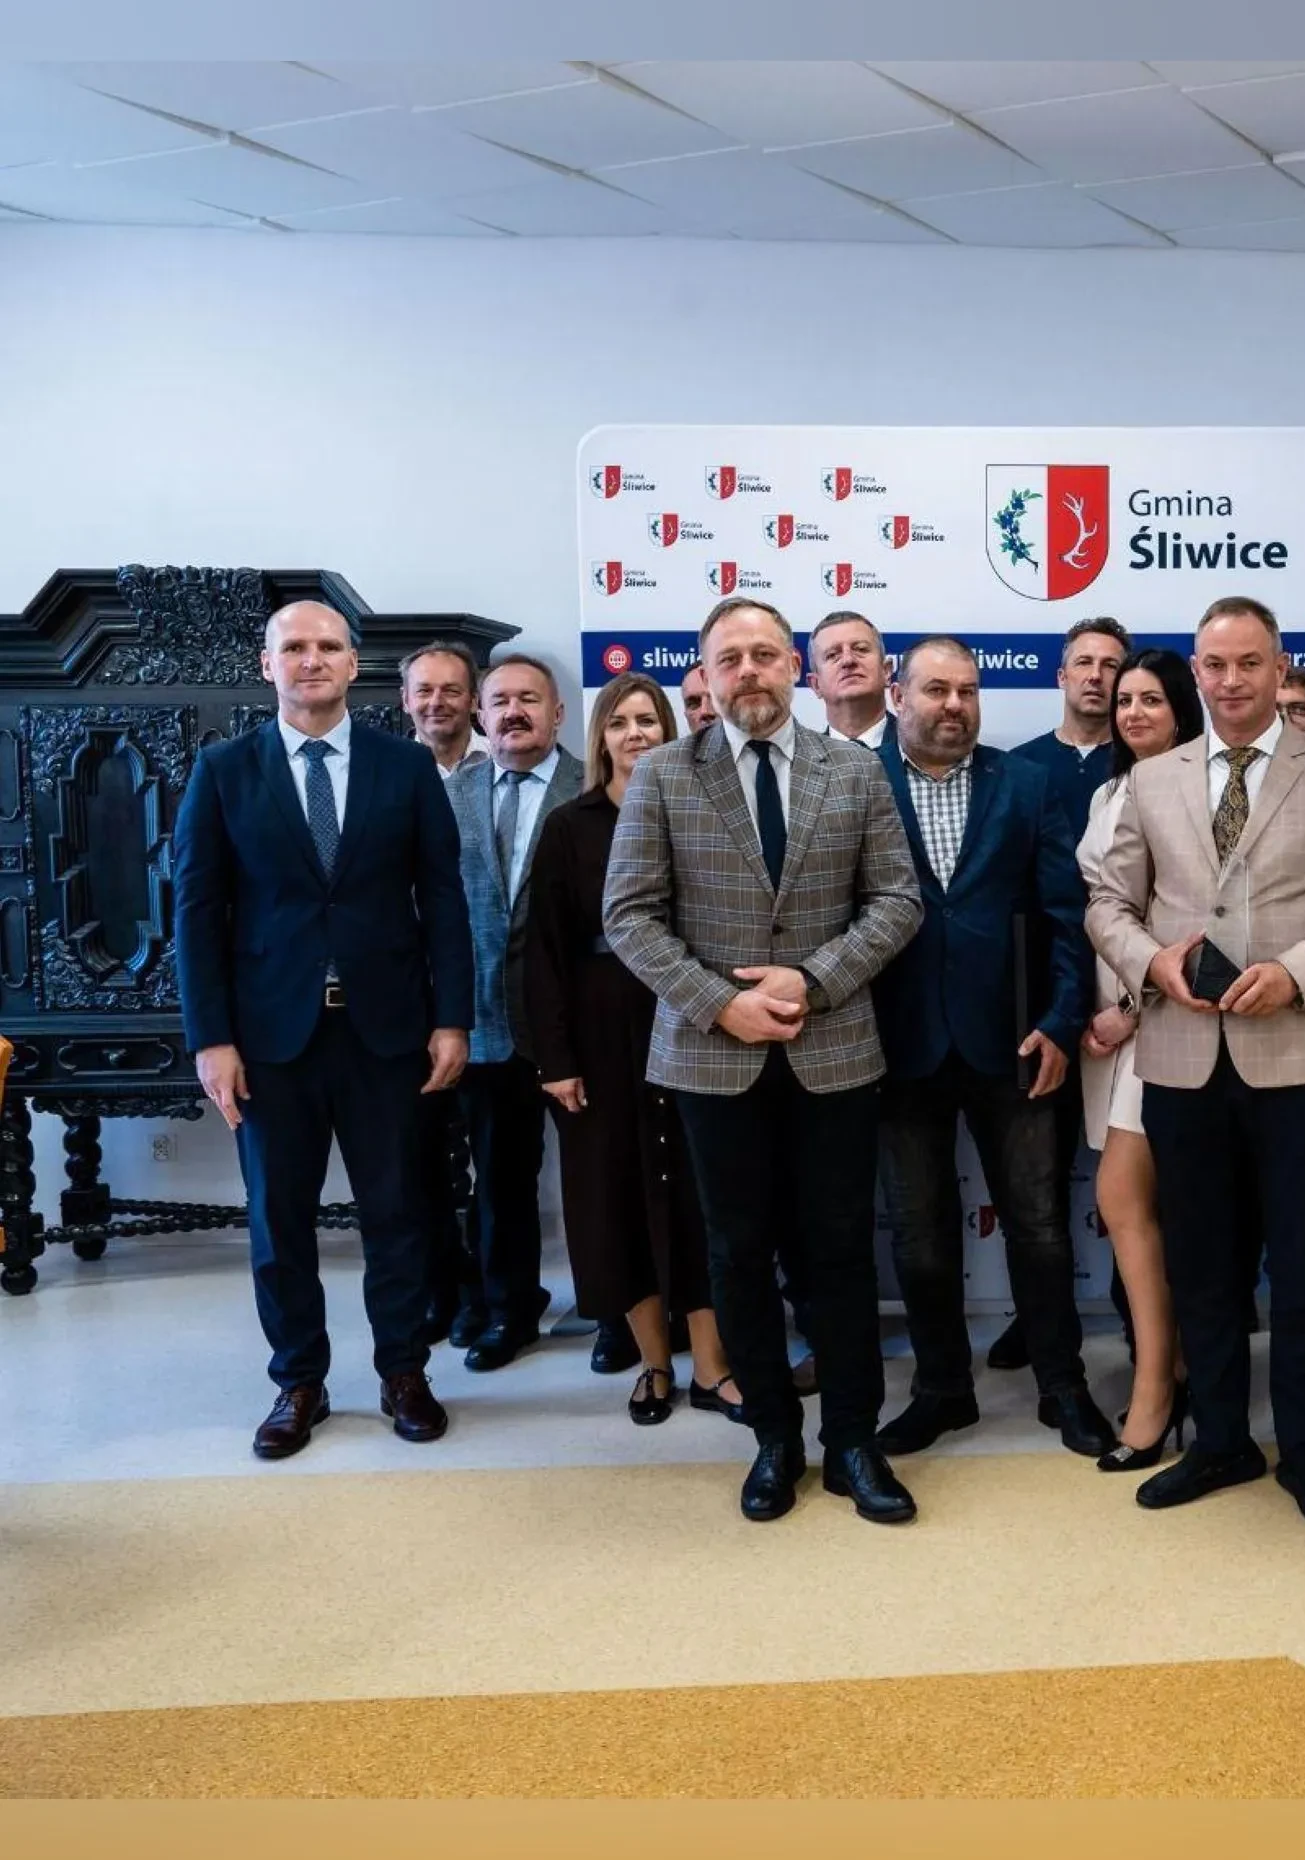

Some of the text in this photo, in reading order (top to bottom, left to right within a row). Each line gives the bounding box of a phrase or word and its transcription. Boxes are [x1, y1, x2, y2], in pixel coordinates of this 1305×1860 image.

[622, 480, 655, 491] Śliwice
[737, 481, 771, 492] Śliwice
[853, 483, 887, 493] Śliwice
[1128, 489, 1233, 517] Gmina
[680, 528, 714, 540] Śliwice
[795, 530, 829, 541] Śliwice
[911, 530, 945, 541] Śliwice
[1128, 525, 1289, 570] Śliwice
[624, 577, 657, 587] Śliwice
[738, 577, 772, 588] Śliwice
[853, 578, 887, 589] Śliwice
[642, 646, 702, 668] sliwi
